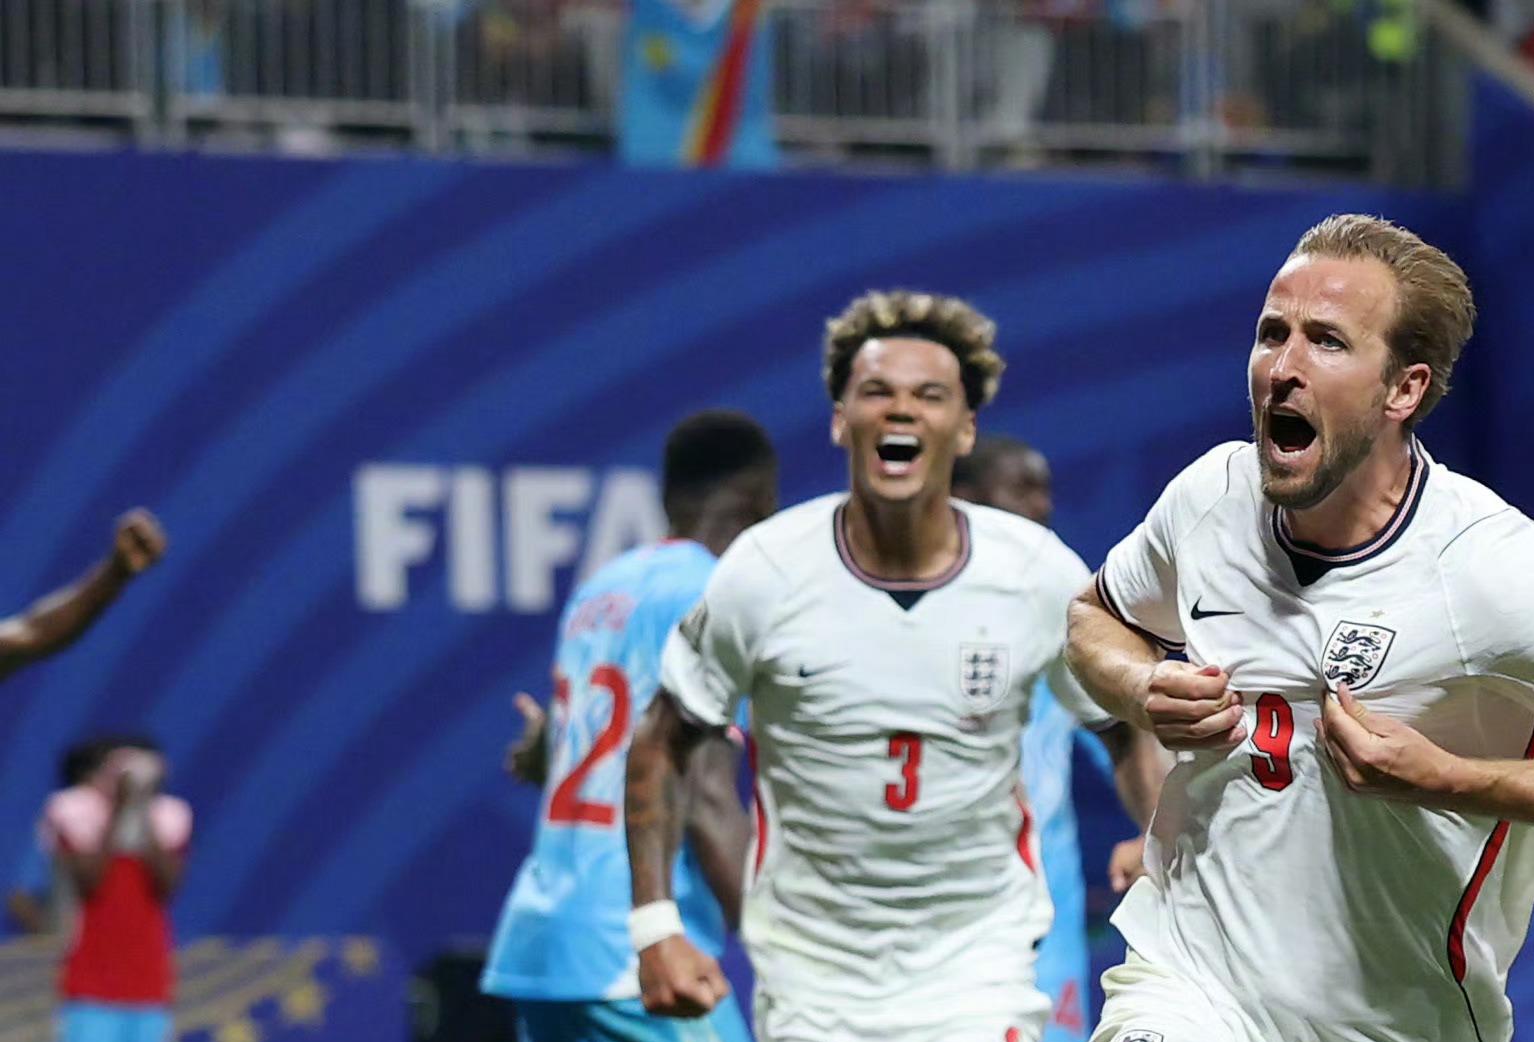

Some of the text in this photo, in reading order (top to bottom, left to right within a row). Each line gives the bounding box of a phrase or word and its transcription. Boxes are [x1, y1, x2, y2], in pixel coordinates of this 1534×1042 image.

[356, 466, 668, 612] FIFA
[885, 731, 922, 812] 3
[1251, 692, 1294, 792] 9
